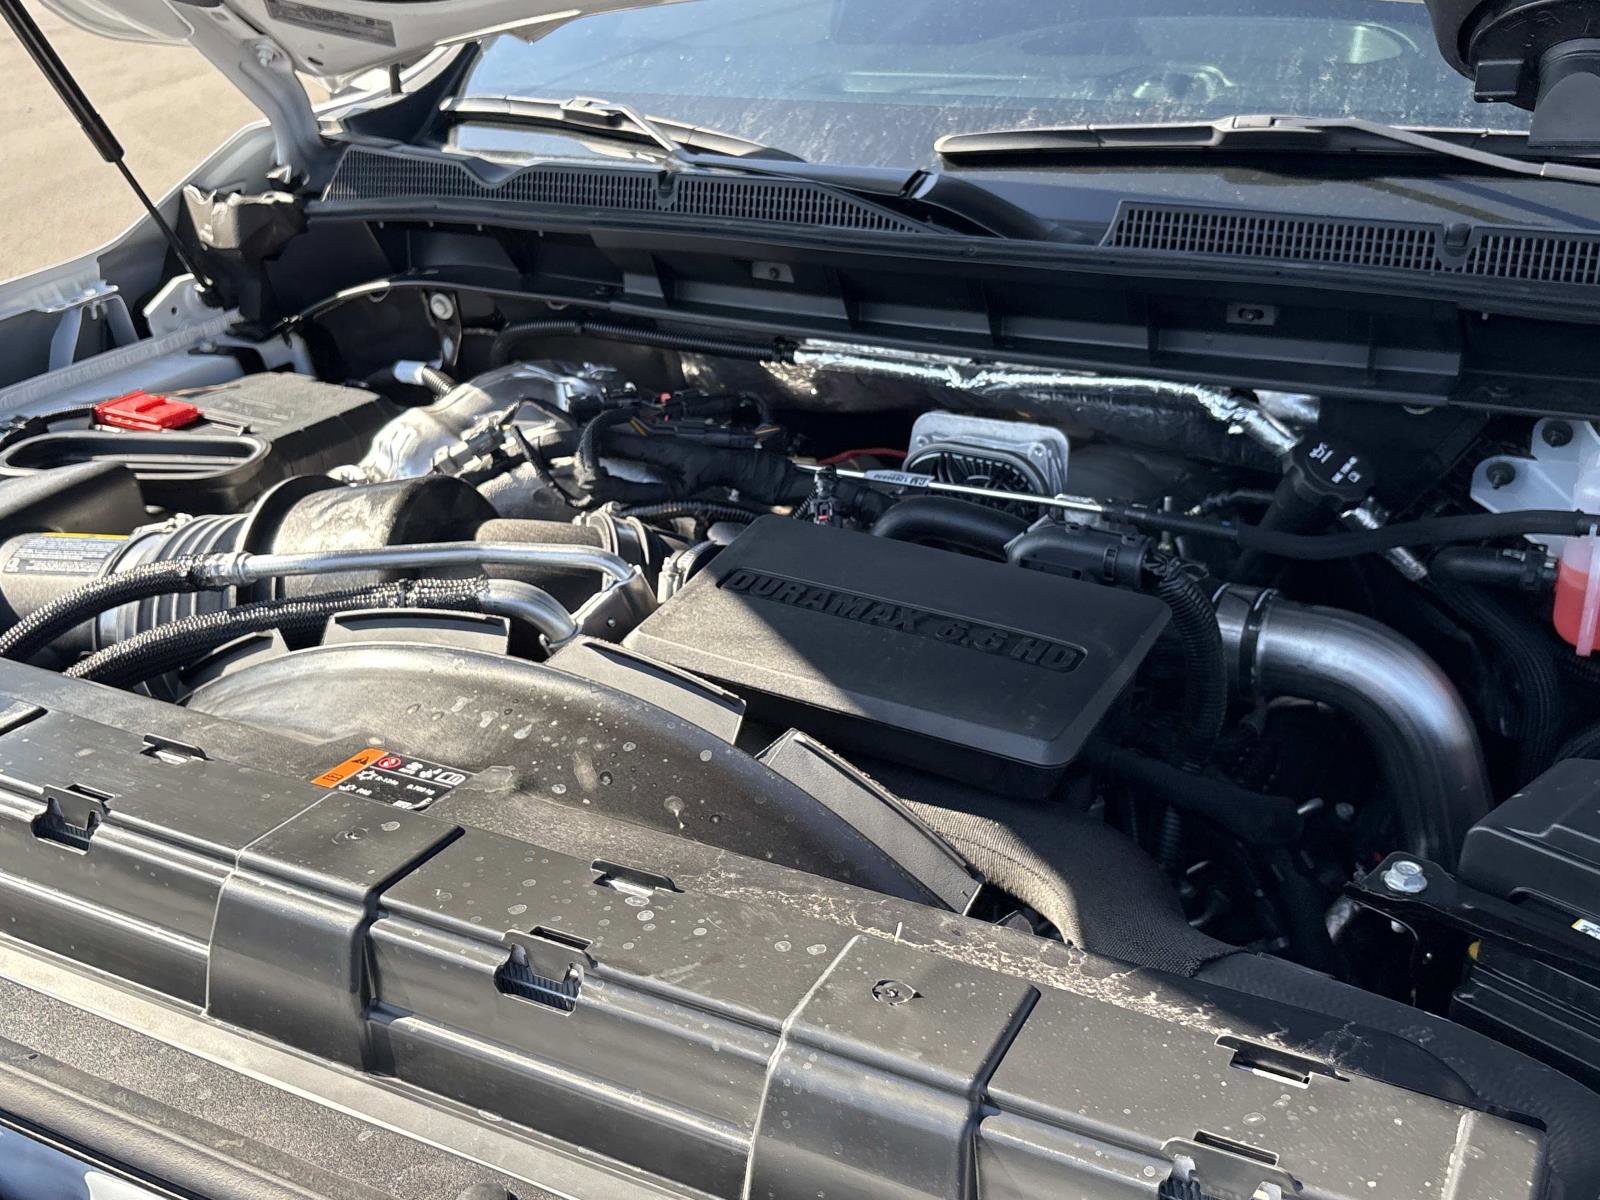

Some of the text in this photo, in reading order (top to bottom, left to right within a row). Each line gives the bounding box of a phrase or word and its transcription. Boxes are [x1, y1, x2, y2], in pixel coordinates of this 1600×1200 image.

[726, 570, 1080, 671] DURAMAX 6.6 HD
